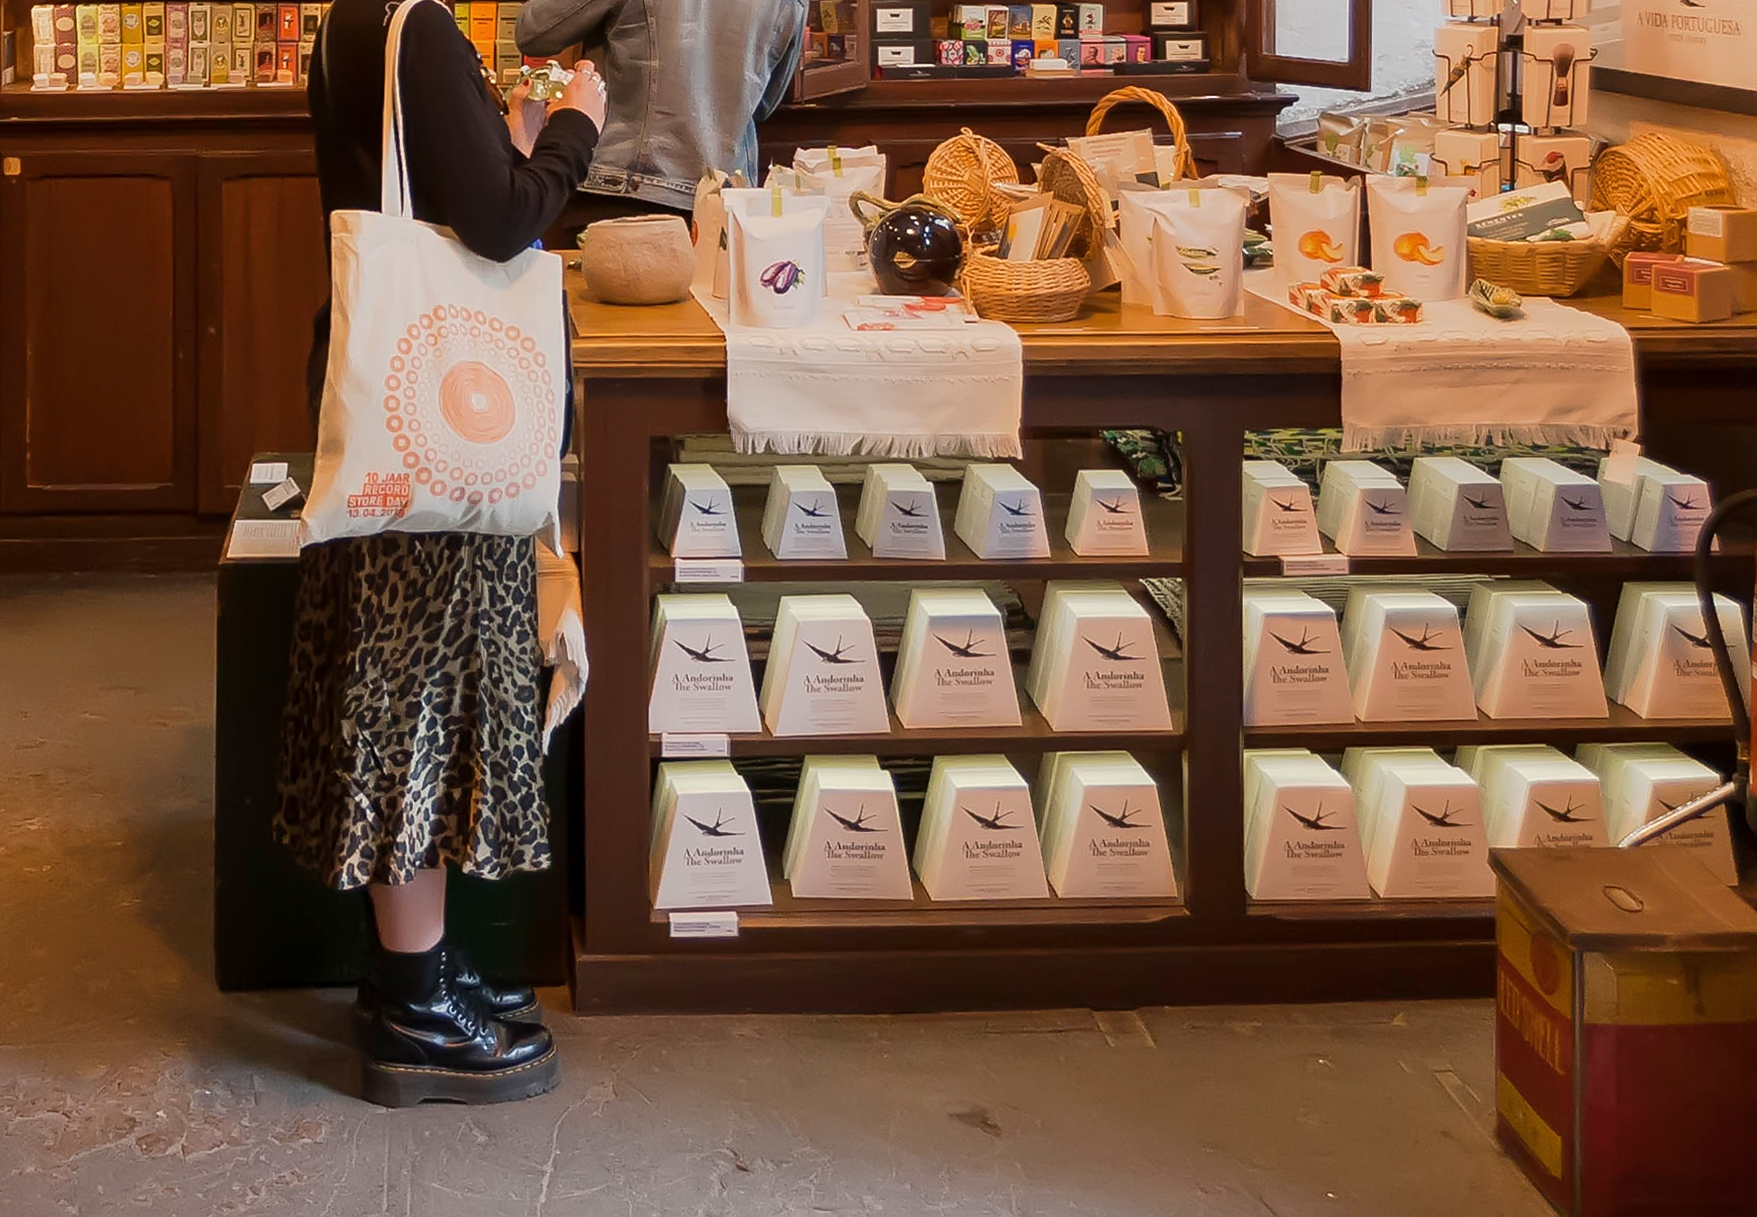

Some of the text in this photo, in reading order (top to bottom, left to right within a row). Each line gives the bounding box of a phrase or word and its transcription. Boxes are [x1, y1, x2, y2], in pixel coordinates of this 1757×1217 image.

[1636, 11, 1741, 36] A VIDA PORTUGUESA
[365, 472, 410, 483] 10 JAAR
[364, 484, 409, 495] RECORD
[348, 496, 408, 507] STORE DAY
